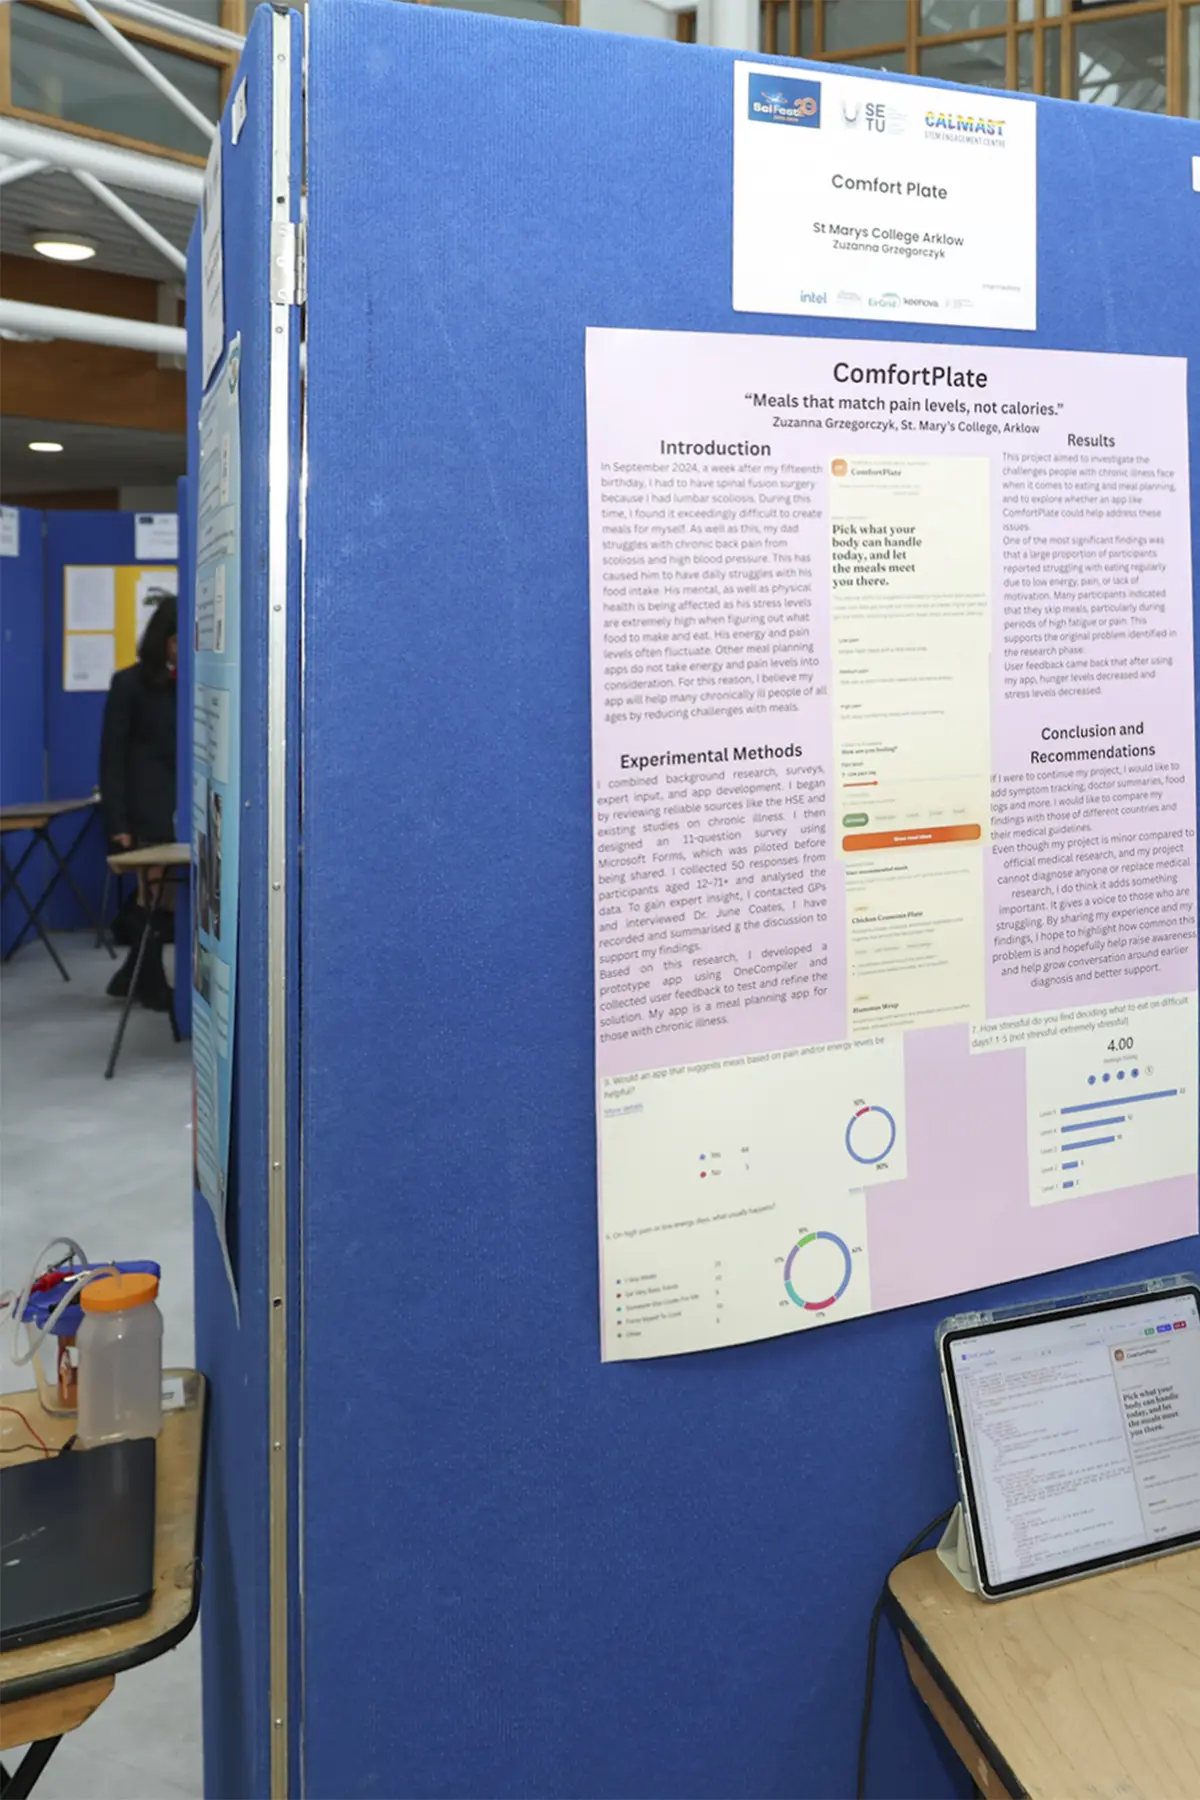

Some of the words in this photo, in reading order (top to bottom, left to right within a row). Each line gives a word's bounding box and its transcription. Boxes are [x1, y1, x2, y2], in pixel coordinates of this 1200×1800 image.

[866, 102, 886, 118] SE
[866, 118, 886, 132] TU
[925, 112, 1006, 136] CALMAST
[831, 173, 901, 194] Comfort
[906, 181, 947, 199] Plate
[812, 221, 825, 233] St
[828, 223, 868, 239] Marys
[871, 227, 919, 244] College
[922, 232, 964, 246] Arklow
[832, 239, 879, 252] Zuzanna
[881, 243, 944, 260] Grzegorczyk
[800, 290, 827, 304] intel
[833, 362, 987, 388] ComfortPlate
[744, 393, 798, 407] “Meals
[802, 395, 834, 409] that
[838, 396, 885, 410] match
[889, 397, 920, 413] pain
[924, 398, 970, 415] levels,
[973, 402, 997, 413] not
[1000, 401, 1063, 415] calories.”
[772, 416, 822, 428] Zuzanna
[824, 418, 898, 432] Grzegorczyk,
[900, 419, 916, 430] St.
[918, 420, 955, 434] Mary’s
[957, 421, 1000, 435] College,
[1003, 422, 1039, 433] Arklow
[660, 440, 772, 456] Introduction
[1067, 434, 1116, 448] Results
[600, 462, 610, 470] In
[612, 462, 669, 473] September
[671, 462, 700, 472] 2024,
[710, 463, 735, 473] week
[737, 463, 761, 473] after
[763, 465, 778, 475] my
[780, 463, 822, 474] fifteenth
[1002, 452, 1019, 461] This
[1021, 453, 1051, 463] project
[1053, 453, 1078, 462] aimed
[1090, 455, 1134, 466] investigate
[1135, 455, 1150, 464] the
[600, 477, 646, 489] birthday,
[654, 478, 674, 488] had
[689, 478, 714, 488] have
[716, 478, 745, 489] spinal
[747, 478, 778, 488] fusion
[779, 480, 816, 490] surgery
[832, 524, 856, 534] Pick
[859, 524, 886, 534] what
[889, 526, 915, 538] your
[832, 538, 859, 550] body
[884, 538, 922, 548] handle
[832, 551, 866, 562] today,
[870, 550, 890, 560] and
[892, 549, 906, 559] let
[832, 563, 850, 573] the
[853, 563, 886, 573] meals
[888, 564, 915, 572] meet
[832, 578, 853, 589] you
[856, 575, 889, 586] there.
[1041, 723, 1116, 740] Conclusion
[1119, 721, 1143, 735] and
[620, 747, 728, 771] Experimental
[733, 743, 802, 760] Methods
[1030, 744, 1155, 763] Recommendations
[996, 872, 1030, 884] cannot
[1031, 869, 1073, 882] diagnose
[1074, 866, 1107, 878] anyone
[1109, 865, 1119, 873] or
[1120, 861, 1154, 873] replace
[1155, 856, 1190, 868] medical
[998, 902, 1048, 916] important.
[1059, 899, 1082, 911] gives
[1091, 895, 1116, 905] voice
[1128, 891, 1154, 901] those
[1155, 888, 1174, 898] who
[1175, 887, 1190, 896] are
[598, 932, 644, 948] recorded
[647, 929, 667, 941] and
[670, 922, 731, 938] summarised
[743, 920, 760, 930] the
[762, 914, 813, 928] discussion
[1030, 974, 1073, 988] diagnosis
[1074, 970, 1092, 981] and
[1094, 968, 1122, 978] better
[1123, 963, 1160, 975] support.
[599, 994, 646, 1011] collected
[649, 992, 672, 1003] user
[674, 985, 721, 999] feedback
[736, 980, 756, 991] test
[758, 977, 778, 988] and
[780, 974, 808, 985] refine
[811, 972, 827, 982] the
[599, 1030, 628, 1043] those
[630, 1025, 653, 1037] with
[654, 1020, 692, 1033] chronic
[694, 1015, 728, 1027] illness.
[1106, 1037, 1134, 1052] 4.00
